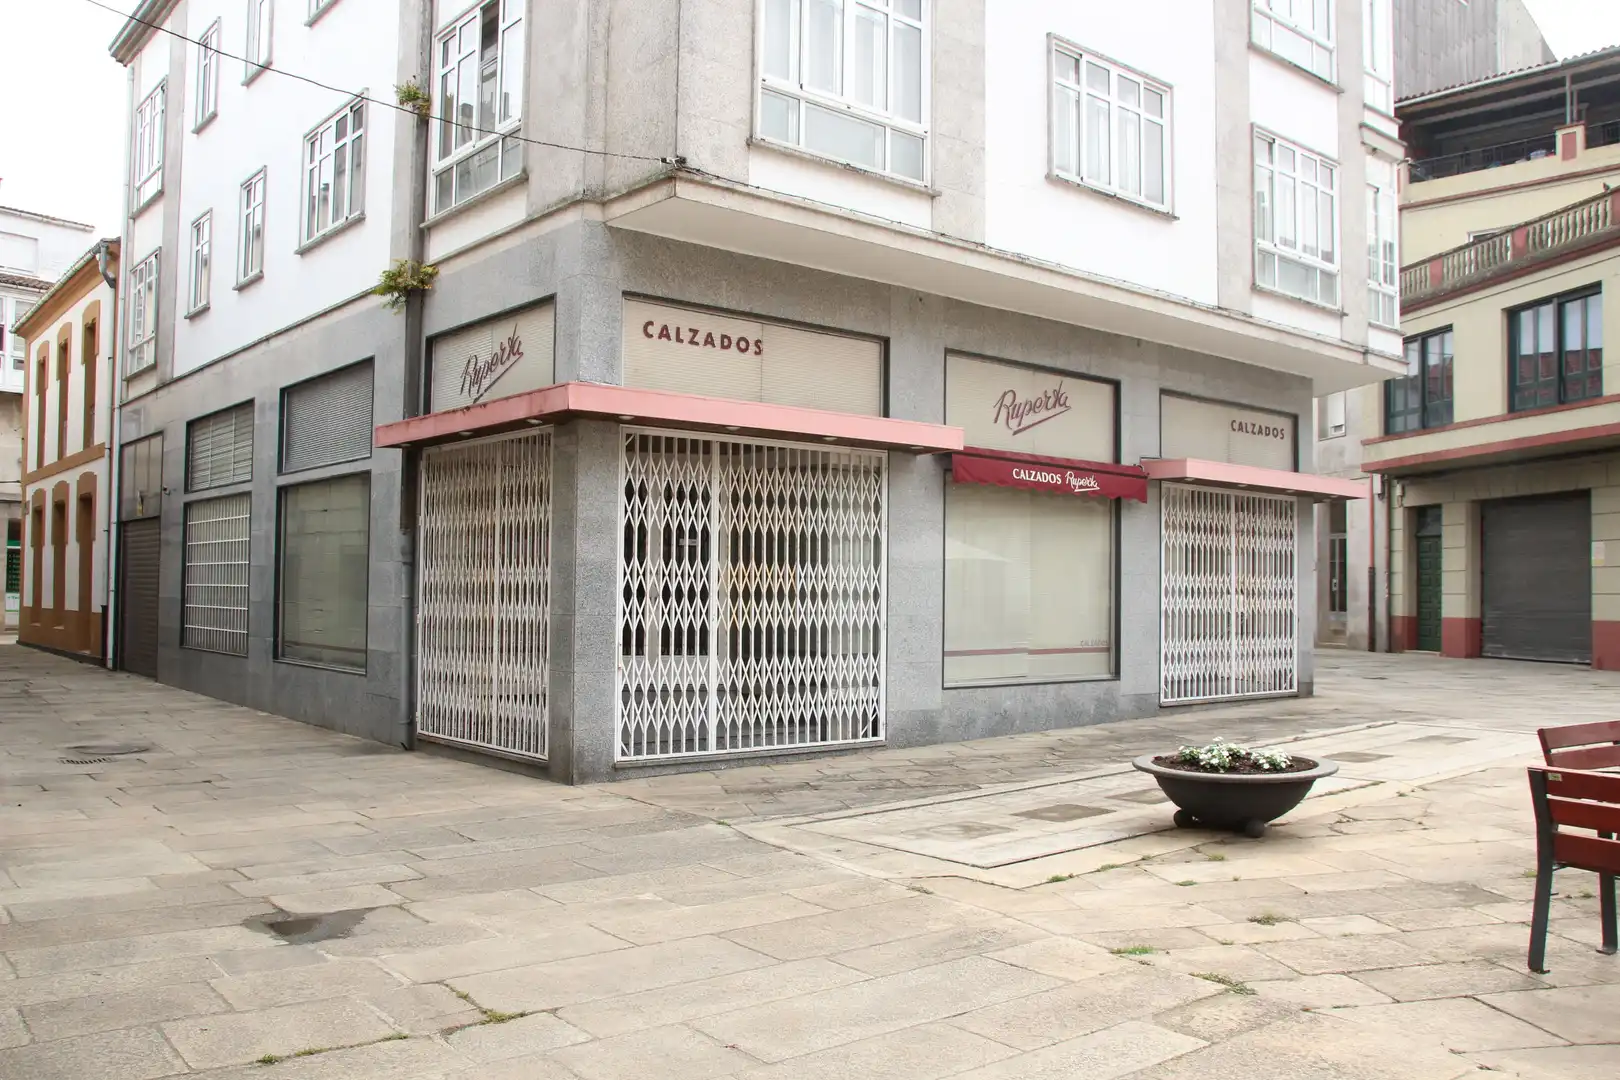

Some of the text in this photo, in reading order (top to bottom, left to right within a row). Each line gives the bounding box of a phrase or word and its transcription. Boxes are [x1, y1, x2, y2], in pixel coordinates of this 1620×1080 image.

[643, 320, 762, 355] CALZADOS
[993, 380, 1071, 435] Ruperta
[1231, 419, 1285, 440] CALZADOS
[1012, 468, 1062, 485] CALZADOS
